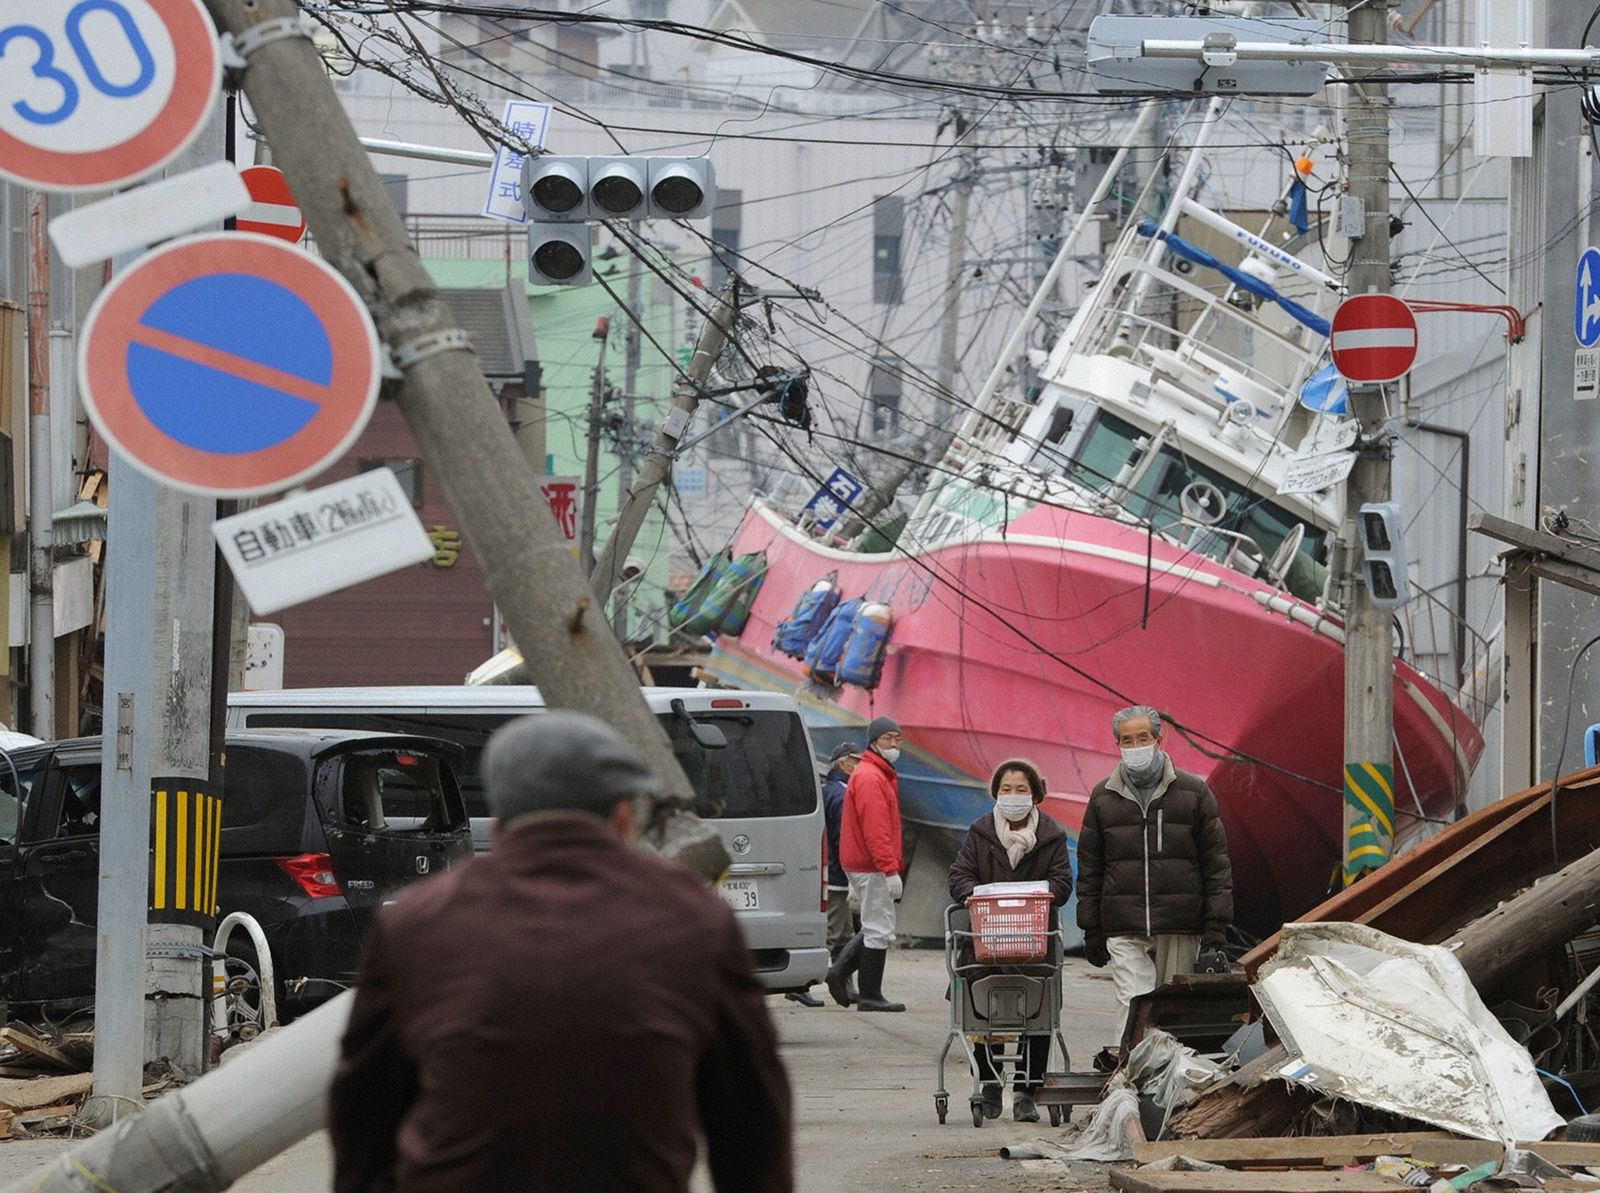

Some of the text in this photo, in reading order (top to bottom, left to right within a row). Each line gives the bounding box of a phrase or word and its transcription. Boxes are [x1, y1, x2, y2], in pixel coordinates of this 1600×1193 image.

[0, 0, 156, 125] 30
[1237, 231, 1301, 270] FURUNO
[120, 698, 132, 764] 宮城県
[348, 880, 374, 889] FREED
